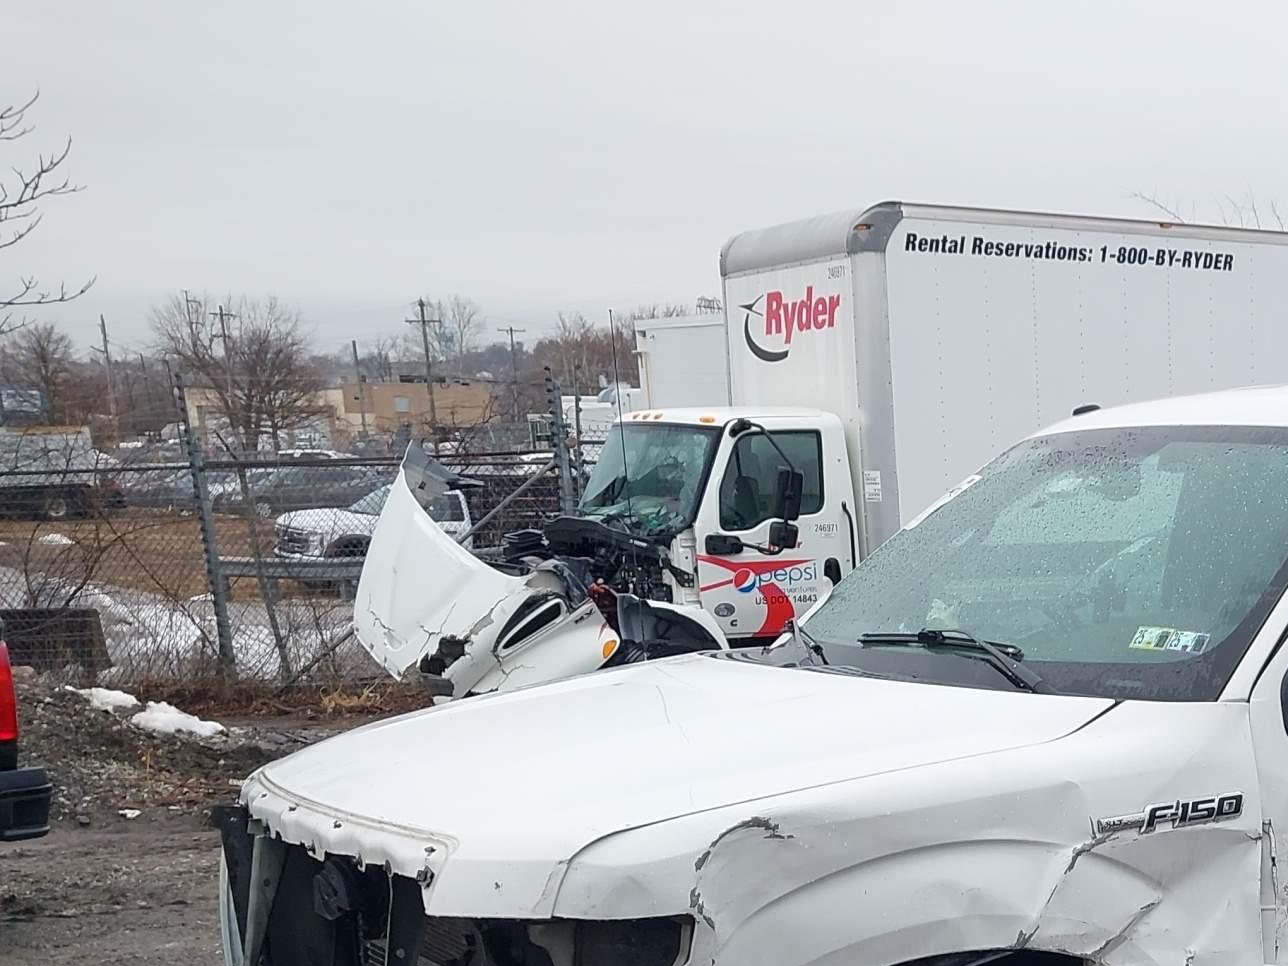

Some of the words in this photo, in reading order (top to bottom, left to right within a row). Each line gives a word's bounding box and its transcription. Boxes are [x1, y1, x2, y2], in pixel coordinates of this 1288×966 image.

[905, 233, 965, 254] Rental
[971, 237, 1093, 263] Reservations:
[1100, 246, 1234, 271] 1-800-BY-RYDER
[765, 286, 840, 345] Ryder
[757, 563, 817, 584] pepsi
[755, 596, 767, 605] US
[771, 596, 790, 604] DOT
[793, 594, 818, 604] 14843
[1141, 793, 1244, 833] F-150
